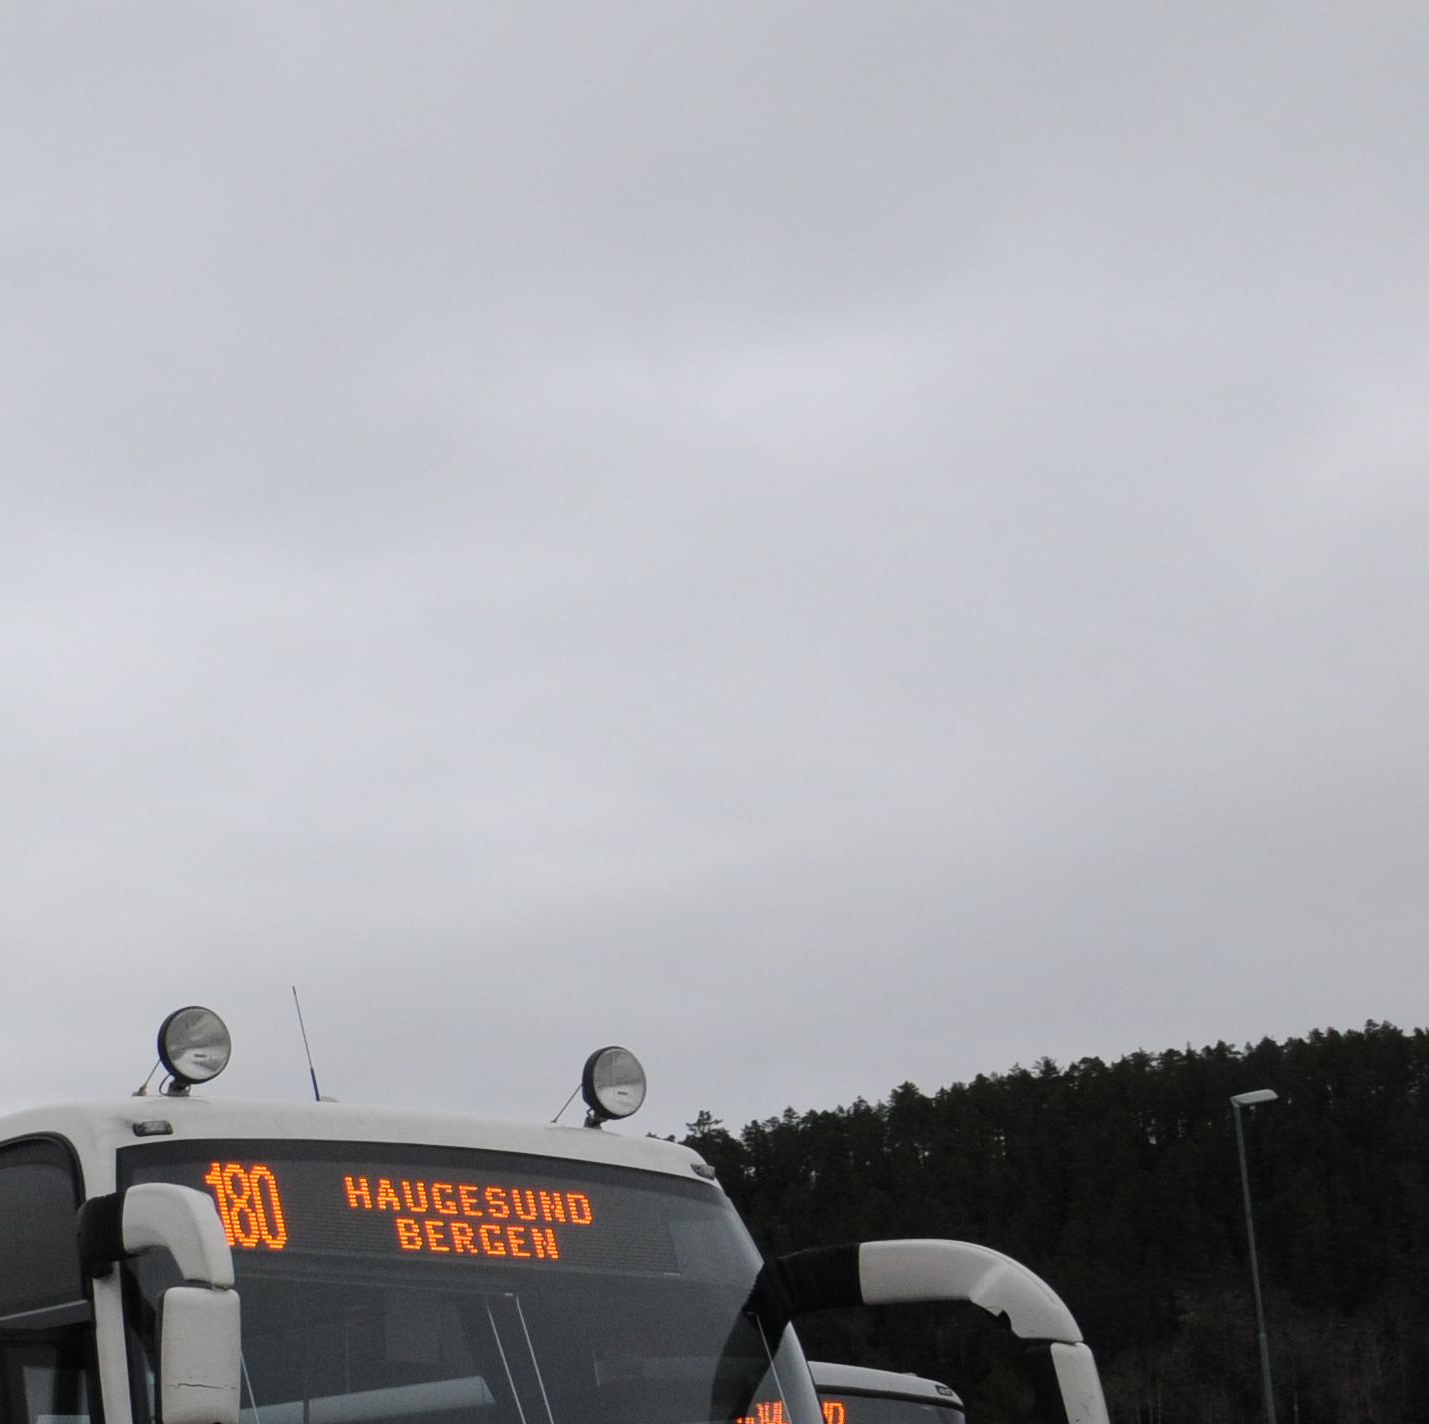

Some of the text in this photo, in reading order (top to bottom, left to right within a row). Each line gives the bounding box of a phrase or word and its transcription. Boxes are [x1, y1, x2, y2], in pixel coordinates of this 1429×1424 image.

[205, 1162, 289, 1250] 180
[344, 1175, 593, 1226] HAUGESUND
[396, 1217, 561, 1260] BERGEN
